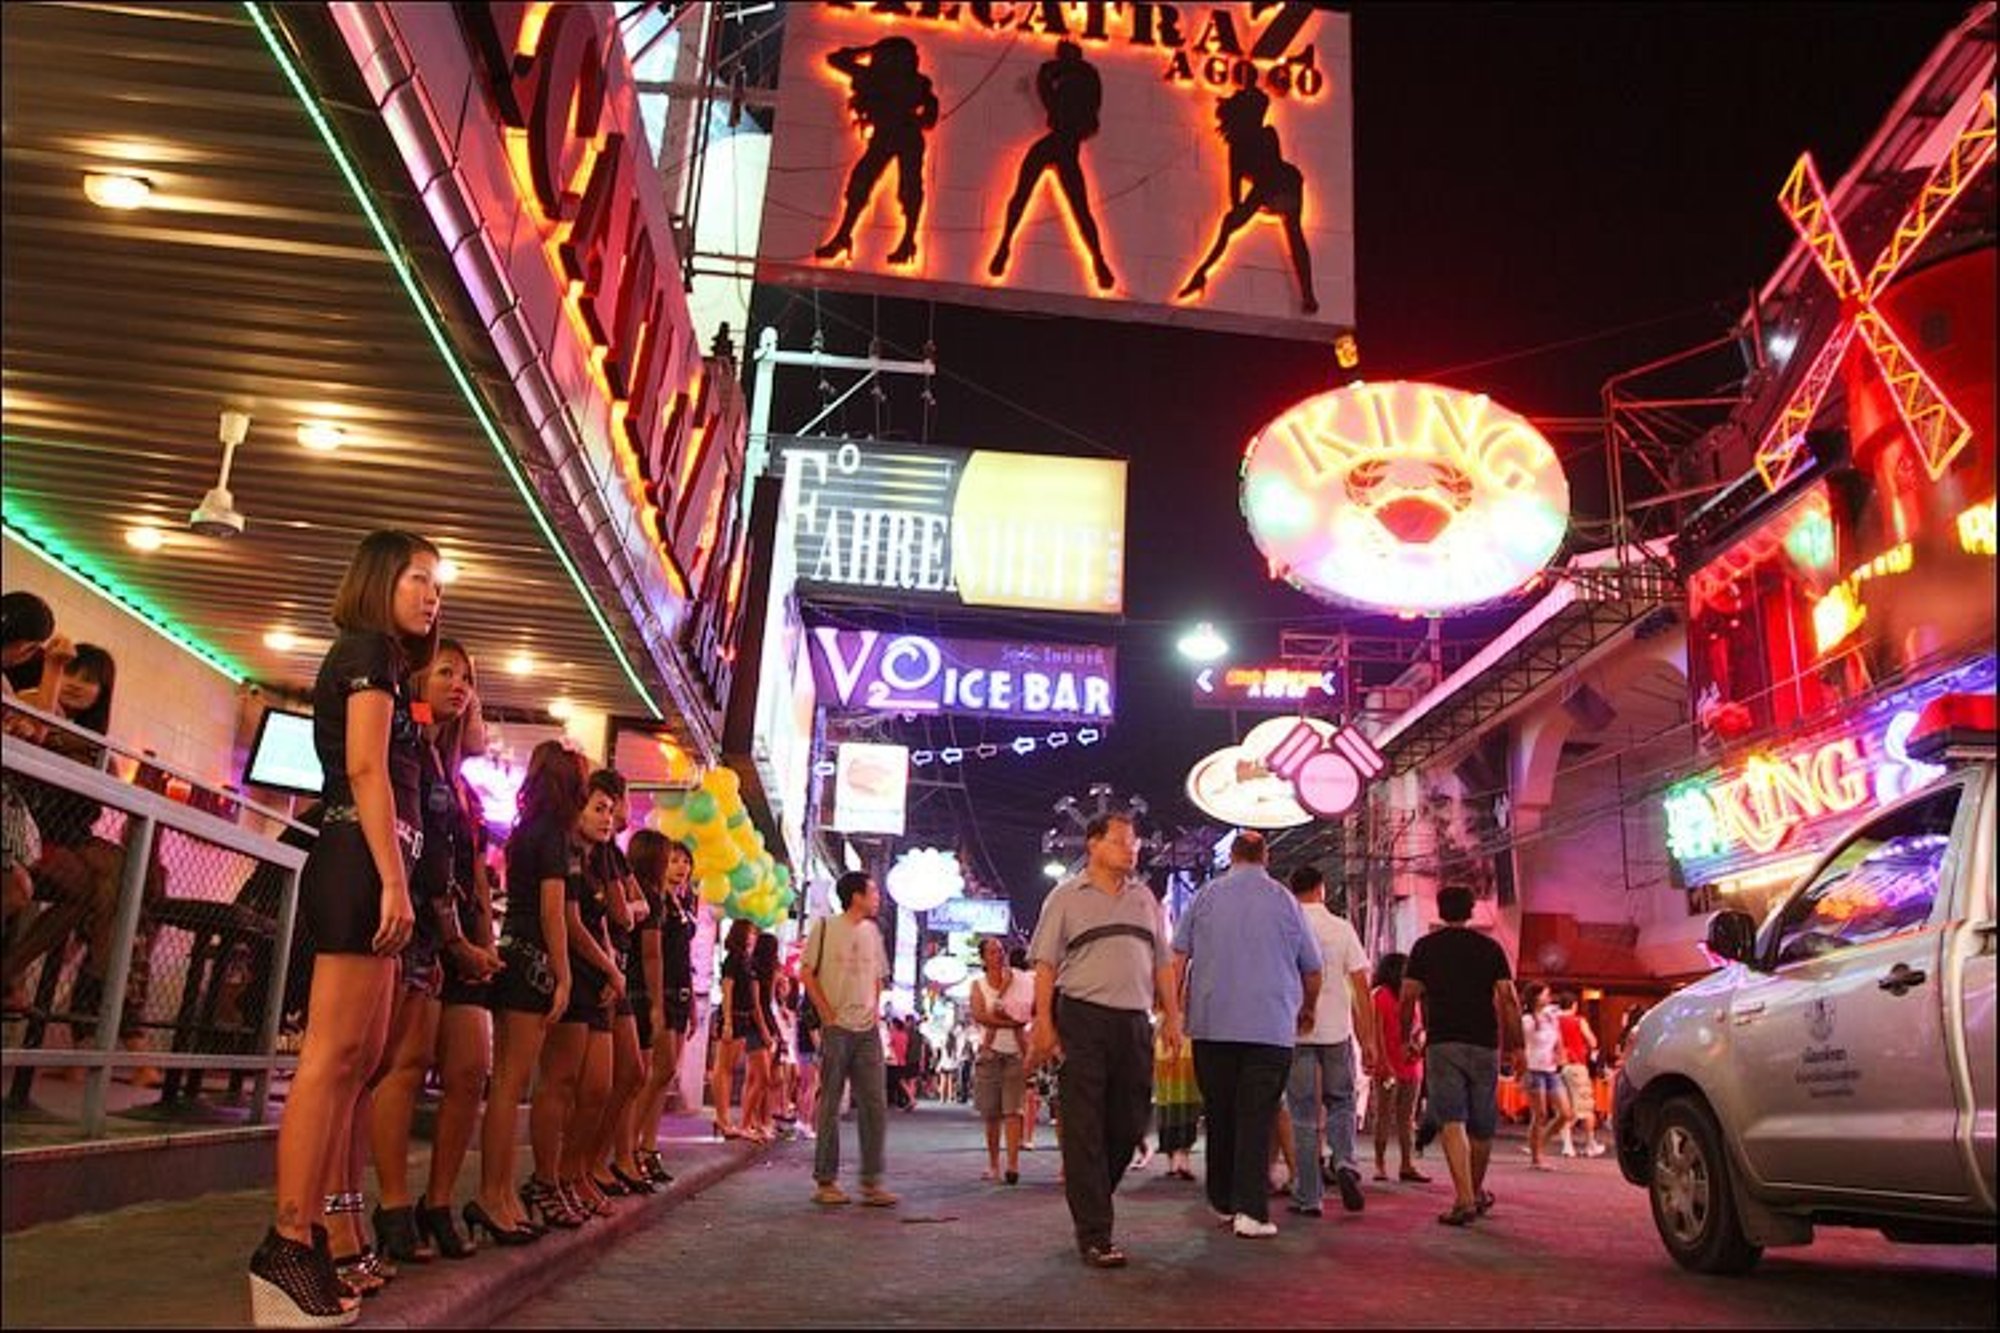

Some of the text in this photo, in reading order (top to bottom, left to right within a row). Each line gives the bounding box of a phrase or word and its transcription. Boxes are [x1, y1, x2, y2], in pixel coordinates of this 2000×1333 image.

[1164, 52, 1195, 81] A
[1275, 388, 1551, 493] KING
[943, 667, 1012, 710] ICE
[1022, 671, 1112, 716] BAR
[1704, 738, 1868, 852] KING
